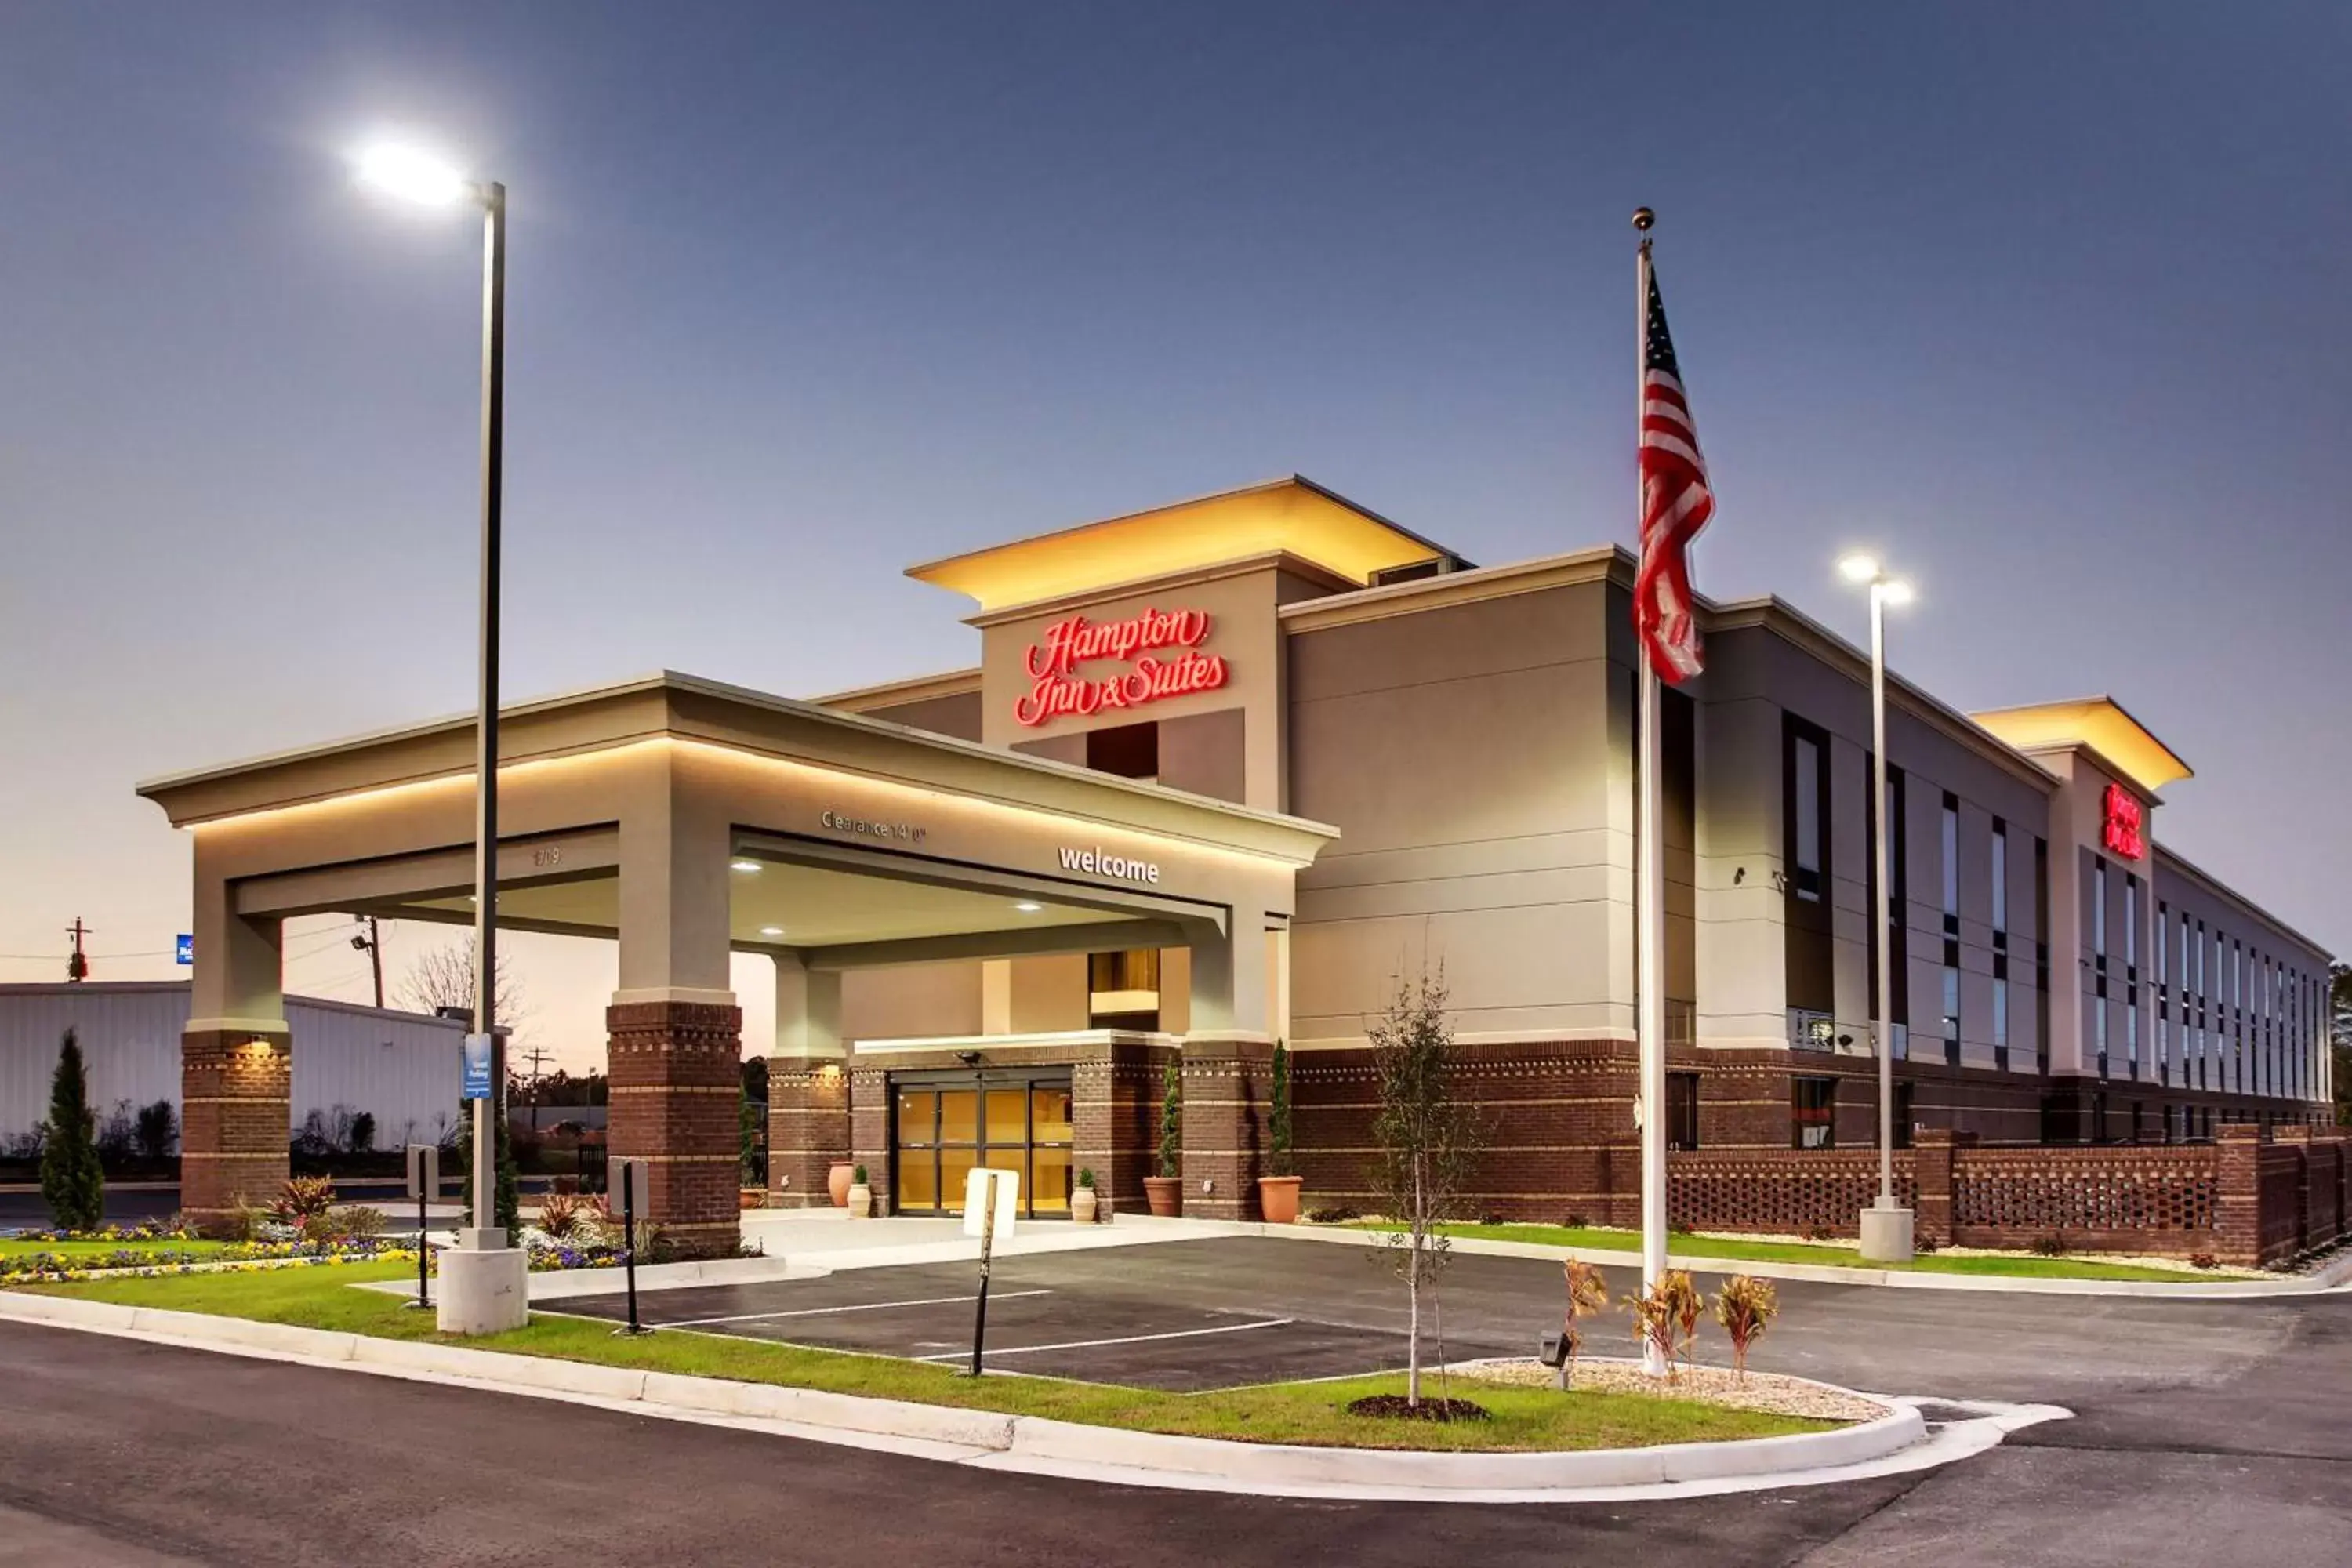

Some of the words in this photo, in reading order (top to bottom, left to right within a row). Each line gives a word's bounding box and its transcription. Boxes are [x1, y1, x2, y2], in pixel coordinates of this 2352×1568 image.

[1026, 608, 1210, 678] Hampton
[1014, 672, 1100, 726] Inn
[1101, 675, 1127, 708] &
[1123, 652, 1229, 702] Suites
[1058, 845, 1160, 884] welcome
